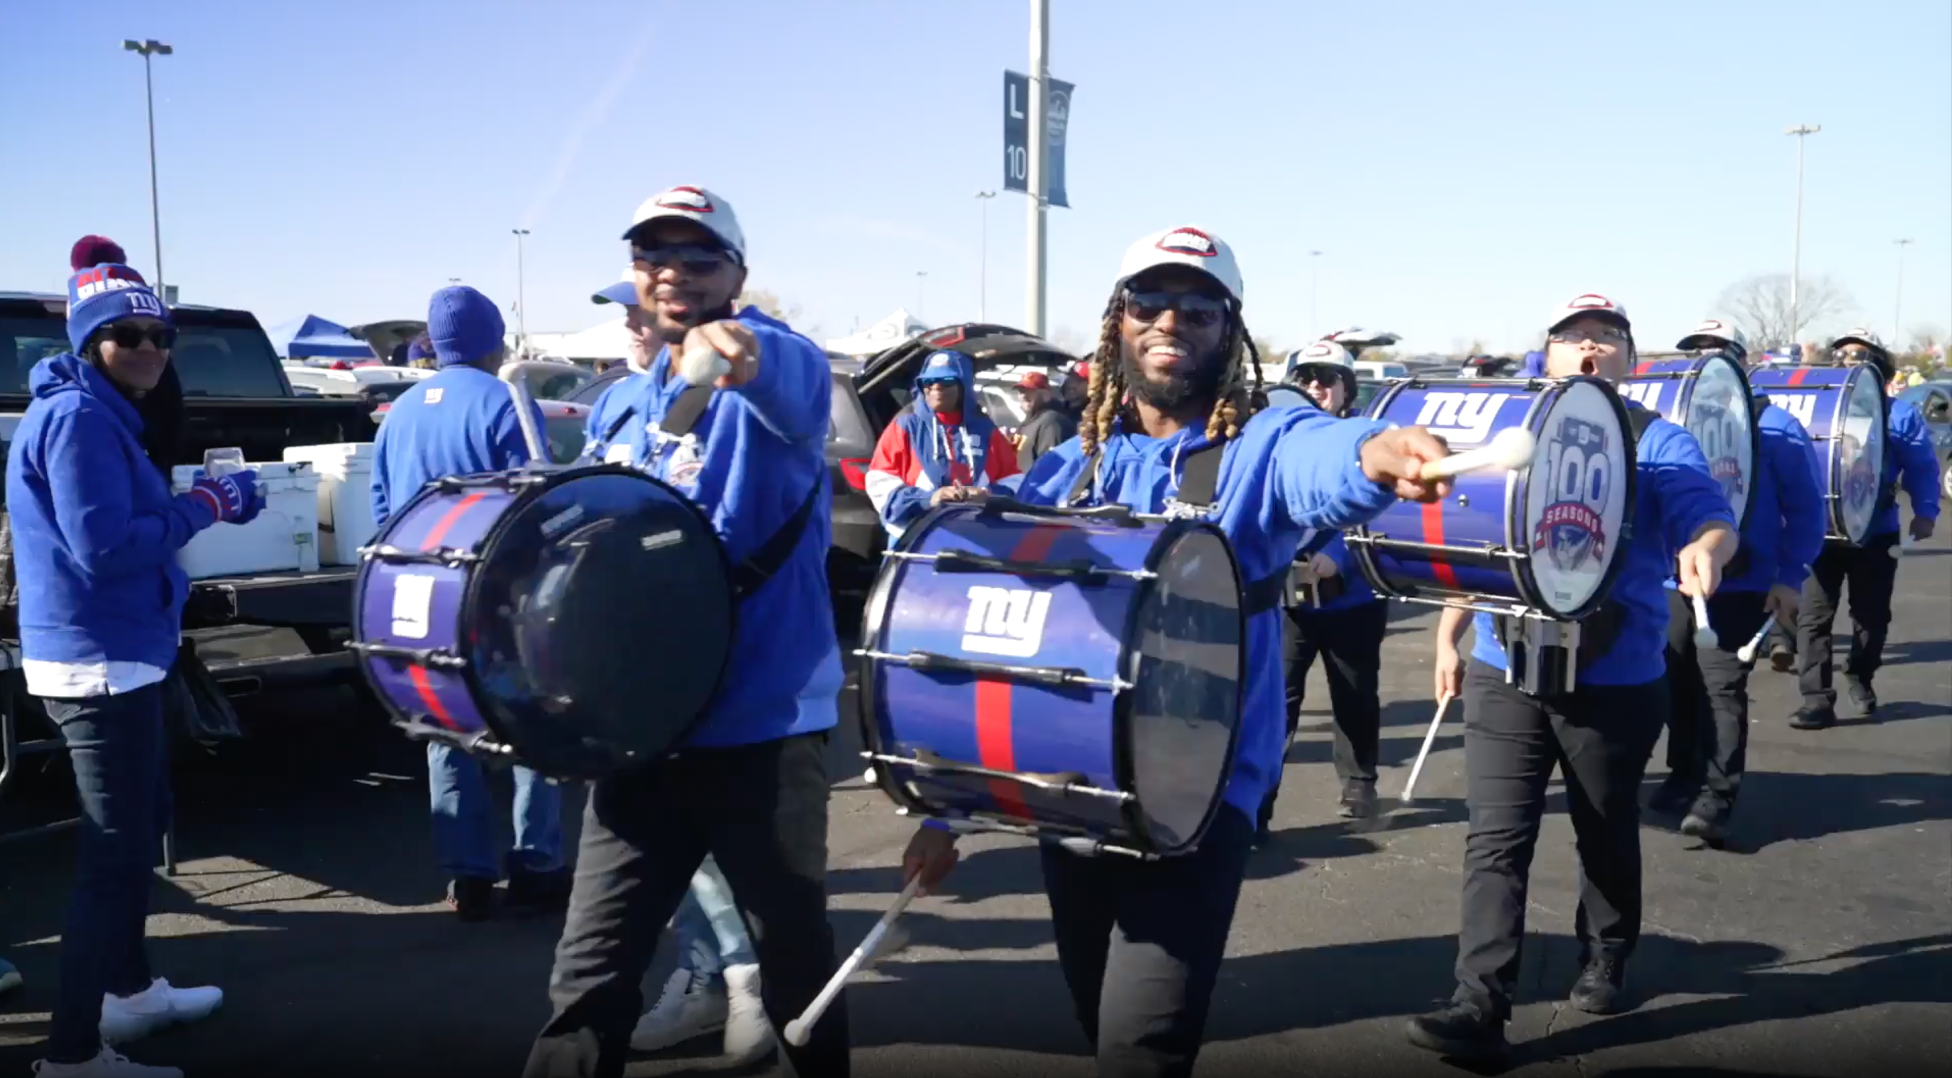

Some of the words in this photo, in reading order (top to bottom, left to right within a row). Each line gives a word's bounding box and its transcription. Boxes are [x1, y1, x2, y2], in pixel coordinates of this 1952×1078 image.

[1010, 83, 1024, 119] L
[1007, 144, 1026, 180] 10
[1546, 440, 1610, 515] 100
